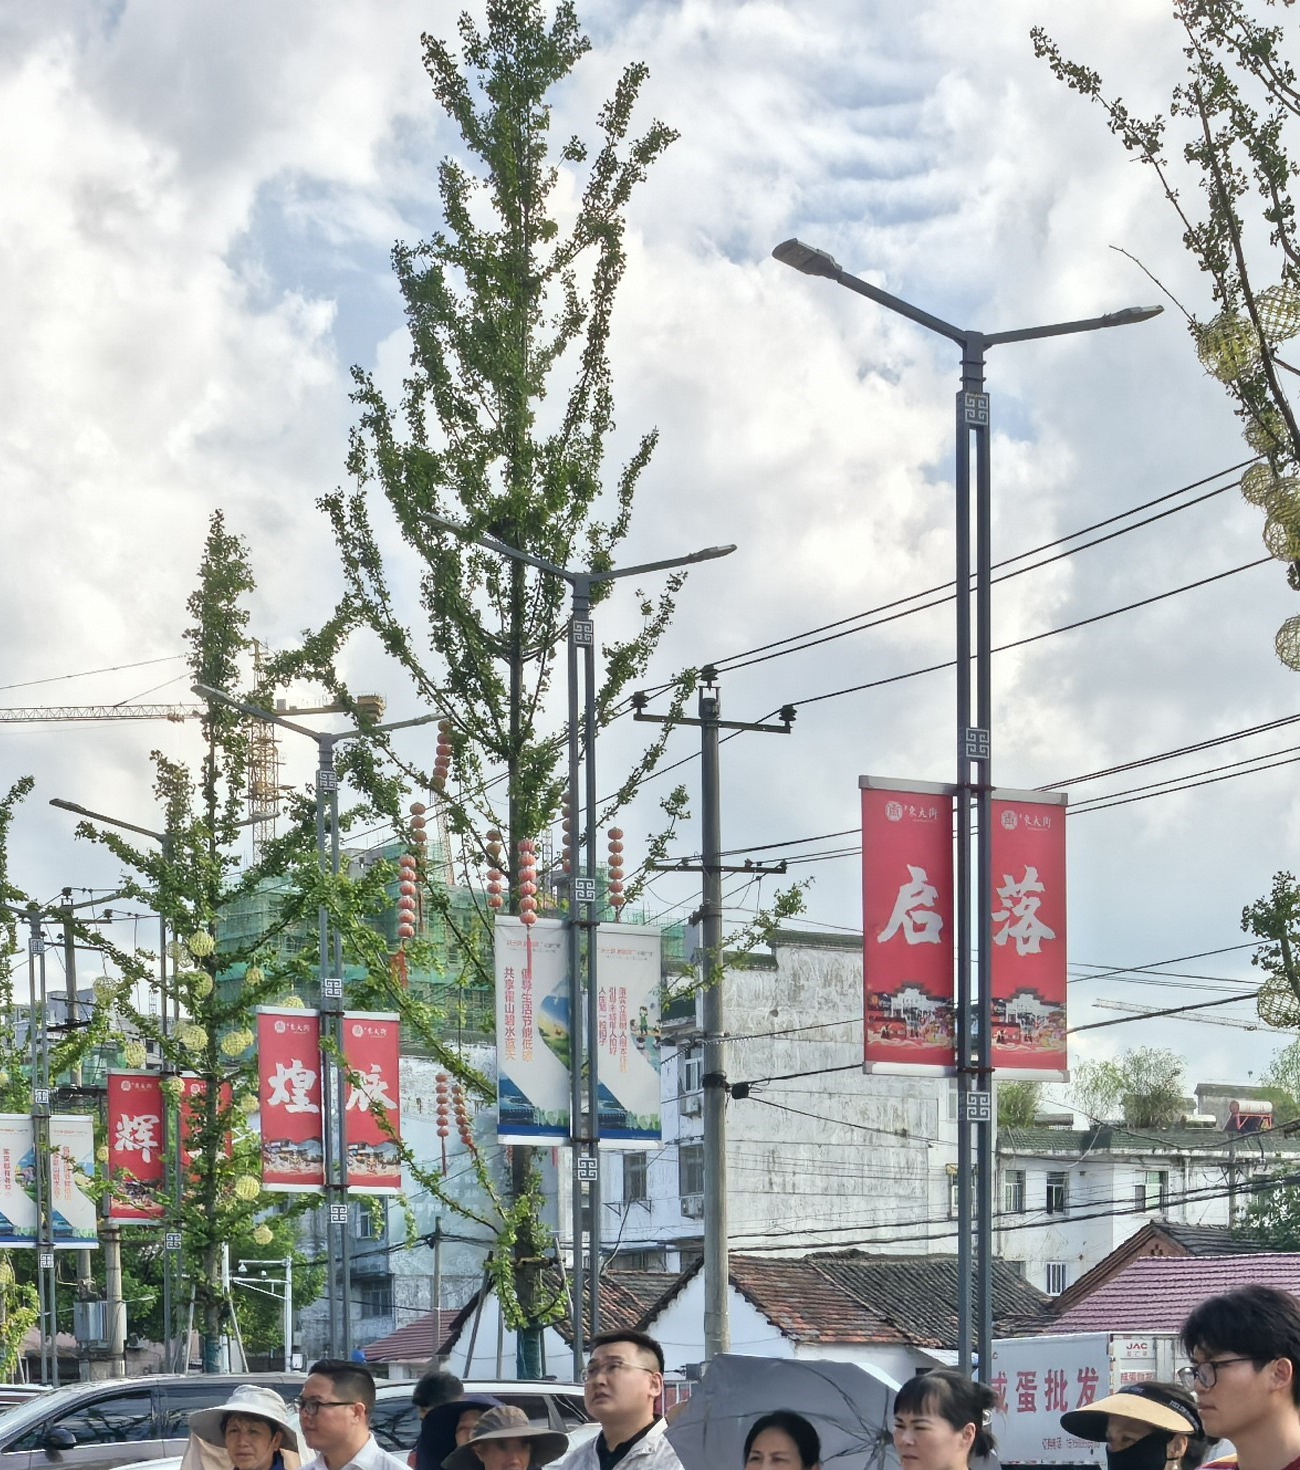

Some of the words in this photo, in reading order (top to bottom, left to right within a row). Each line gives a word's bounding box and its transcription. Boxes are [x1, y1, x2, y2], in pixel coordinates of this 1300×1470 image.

[877, 864, 944, 945] 启
[991, 865, 1056, 957] 落
[267, 1058, 319, 1114] 煌
[114, 1113, 160, 1164] 辉
[1126, 1342, 1148, 1350] JAC
